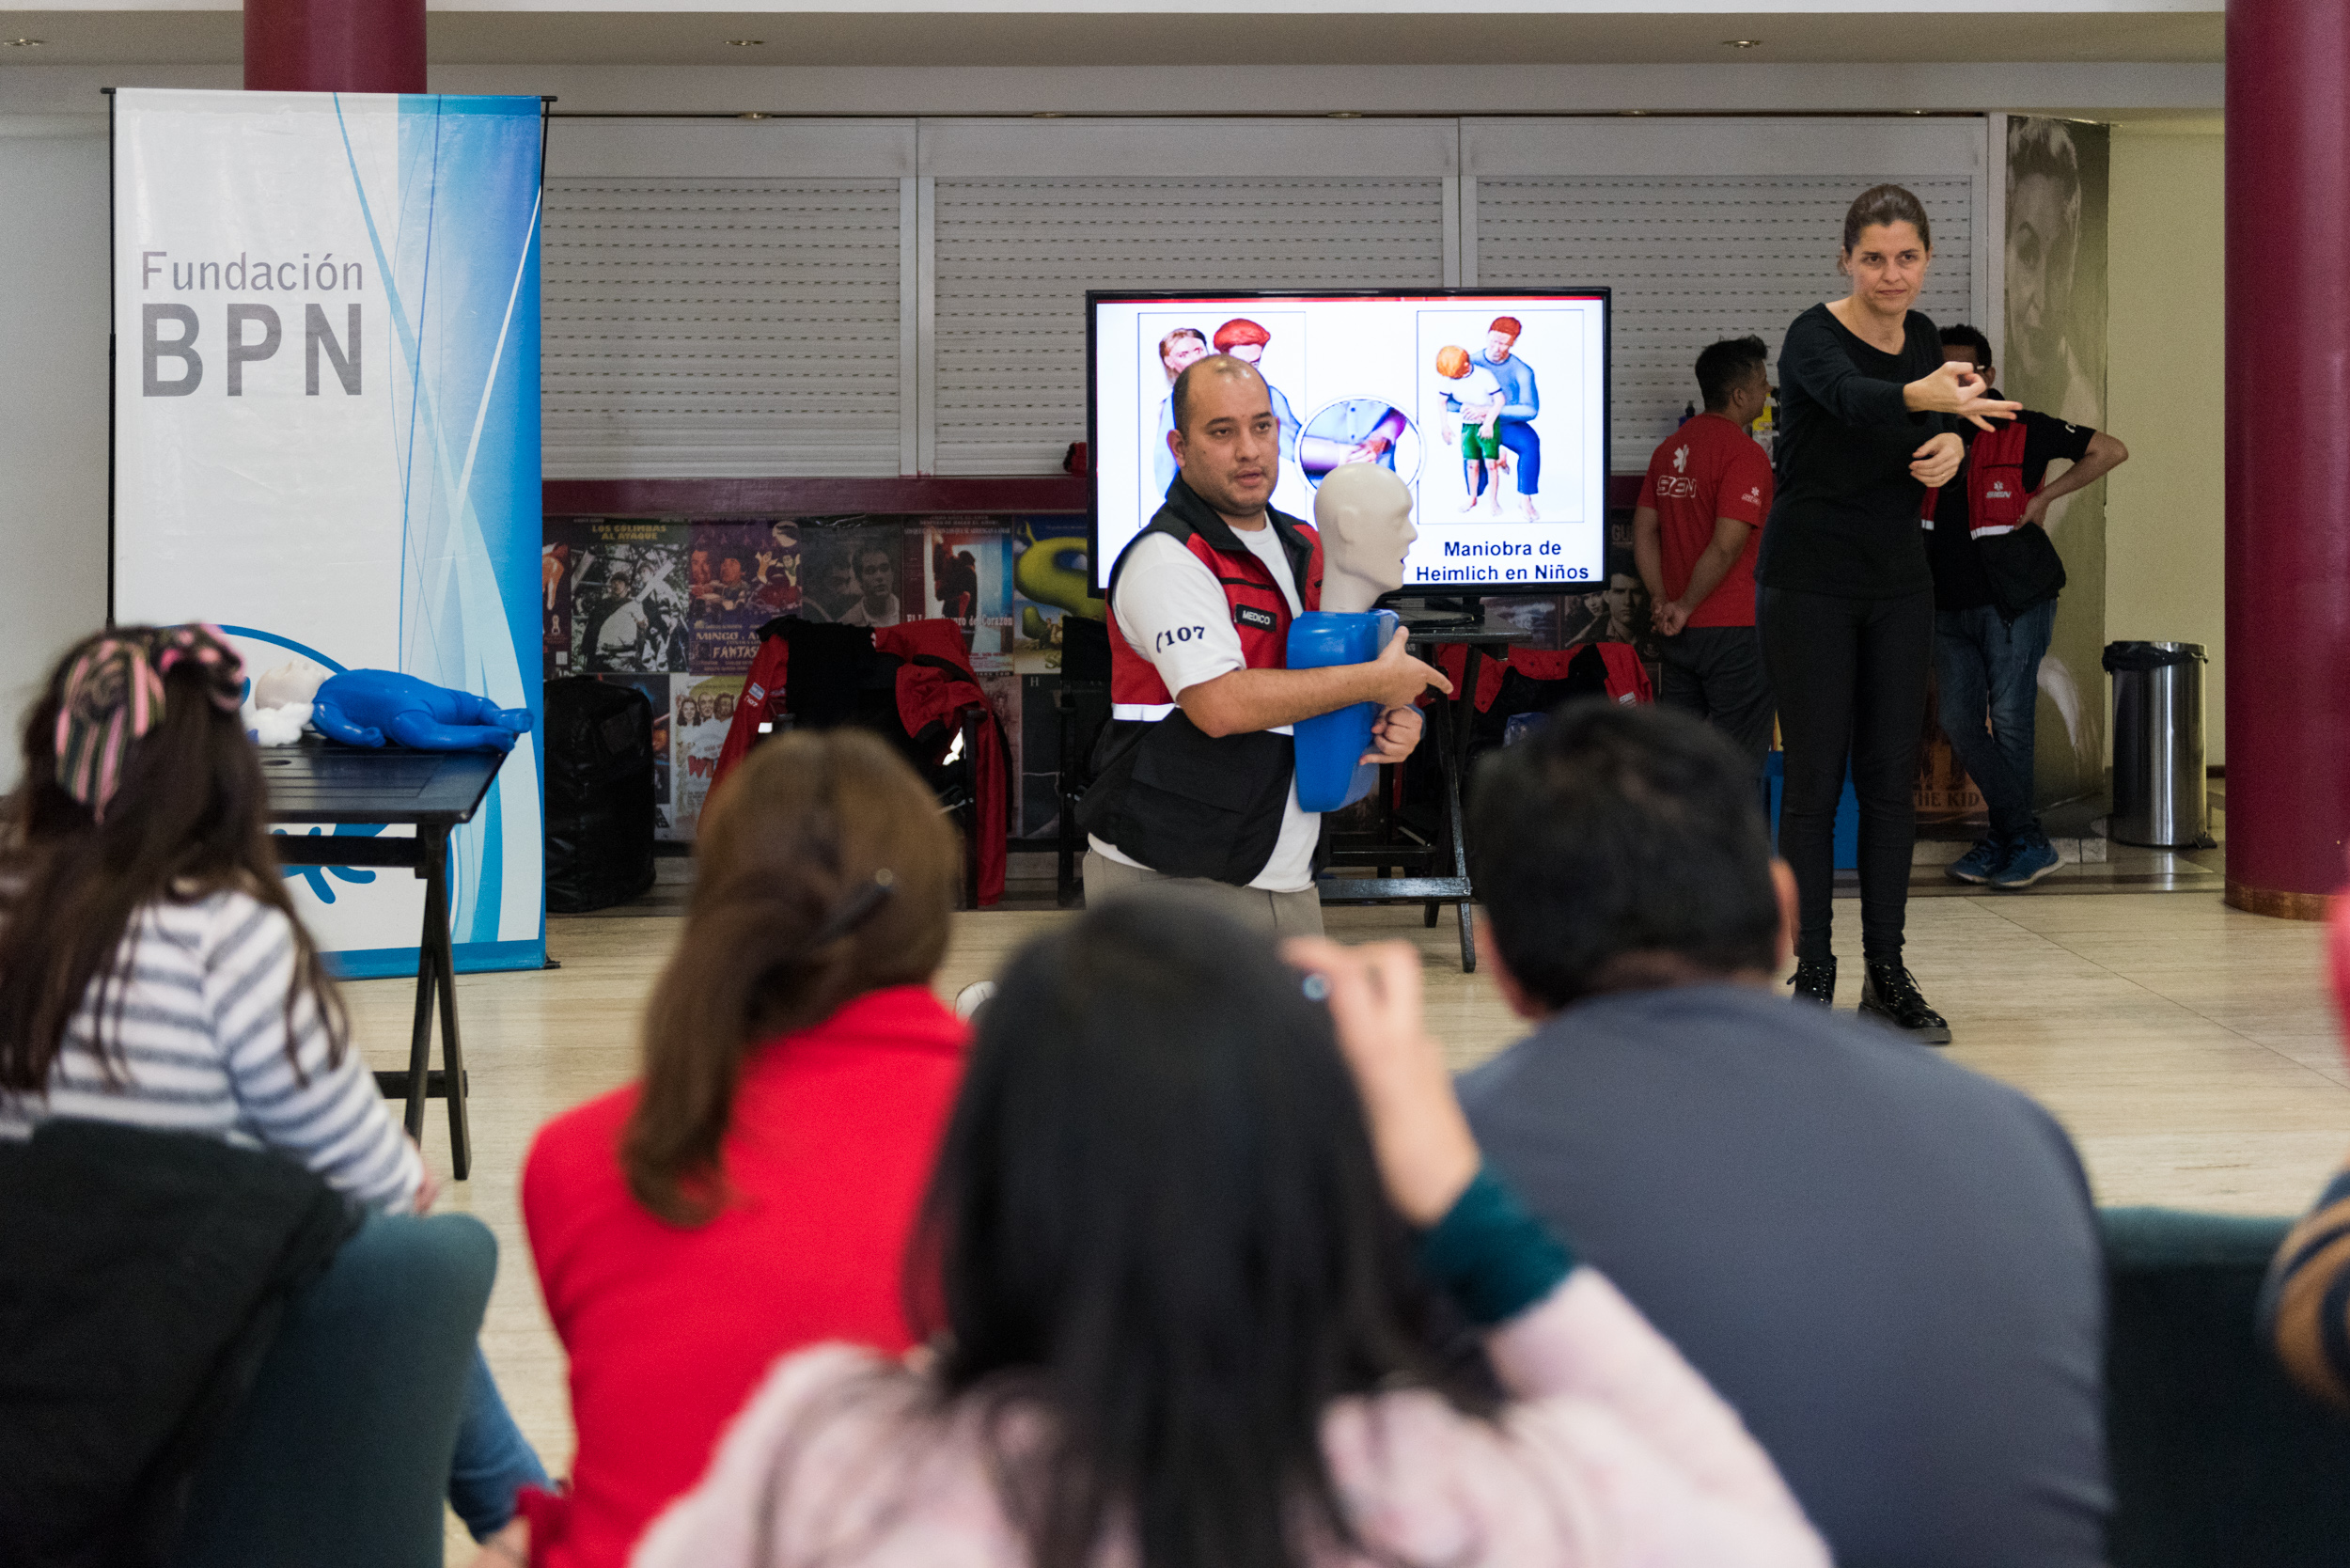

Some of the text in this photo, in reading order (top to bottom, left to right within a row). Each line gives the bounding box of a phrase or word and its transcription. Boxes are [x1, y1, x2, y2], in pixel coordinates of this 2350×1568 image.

[142, 251, 363, 291] Fundación
[142, 303, 363, 398] BPN
[1444, 541, 1561, 557] Maniobra de
[1416, 564, 1589, 581] Heimlich en Niños
[1242, 610, 1271, 625] MEDICO
[696, 632, 739, 640] MINGO
[1948, 792, 1980, 807] KID
